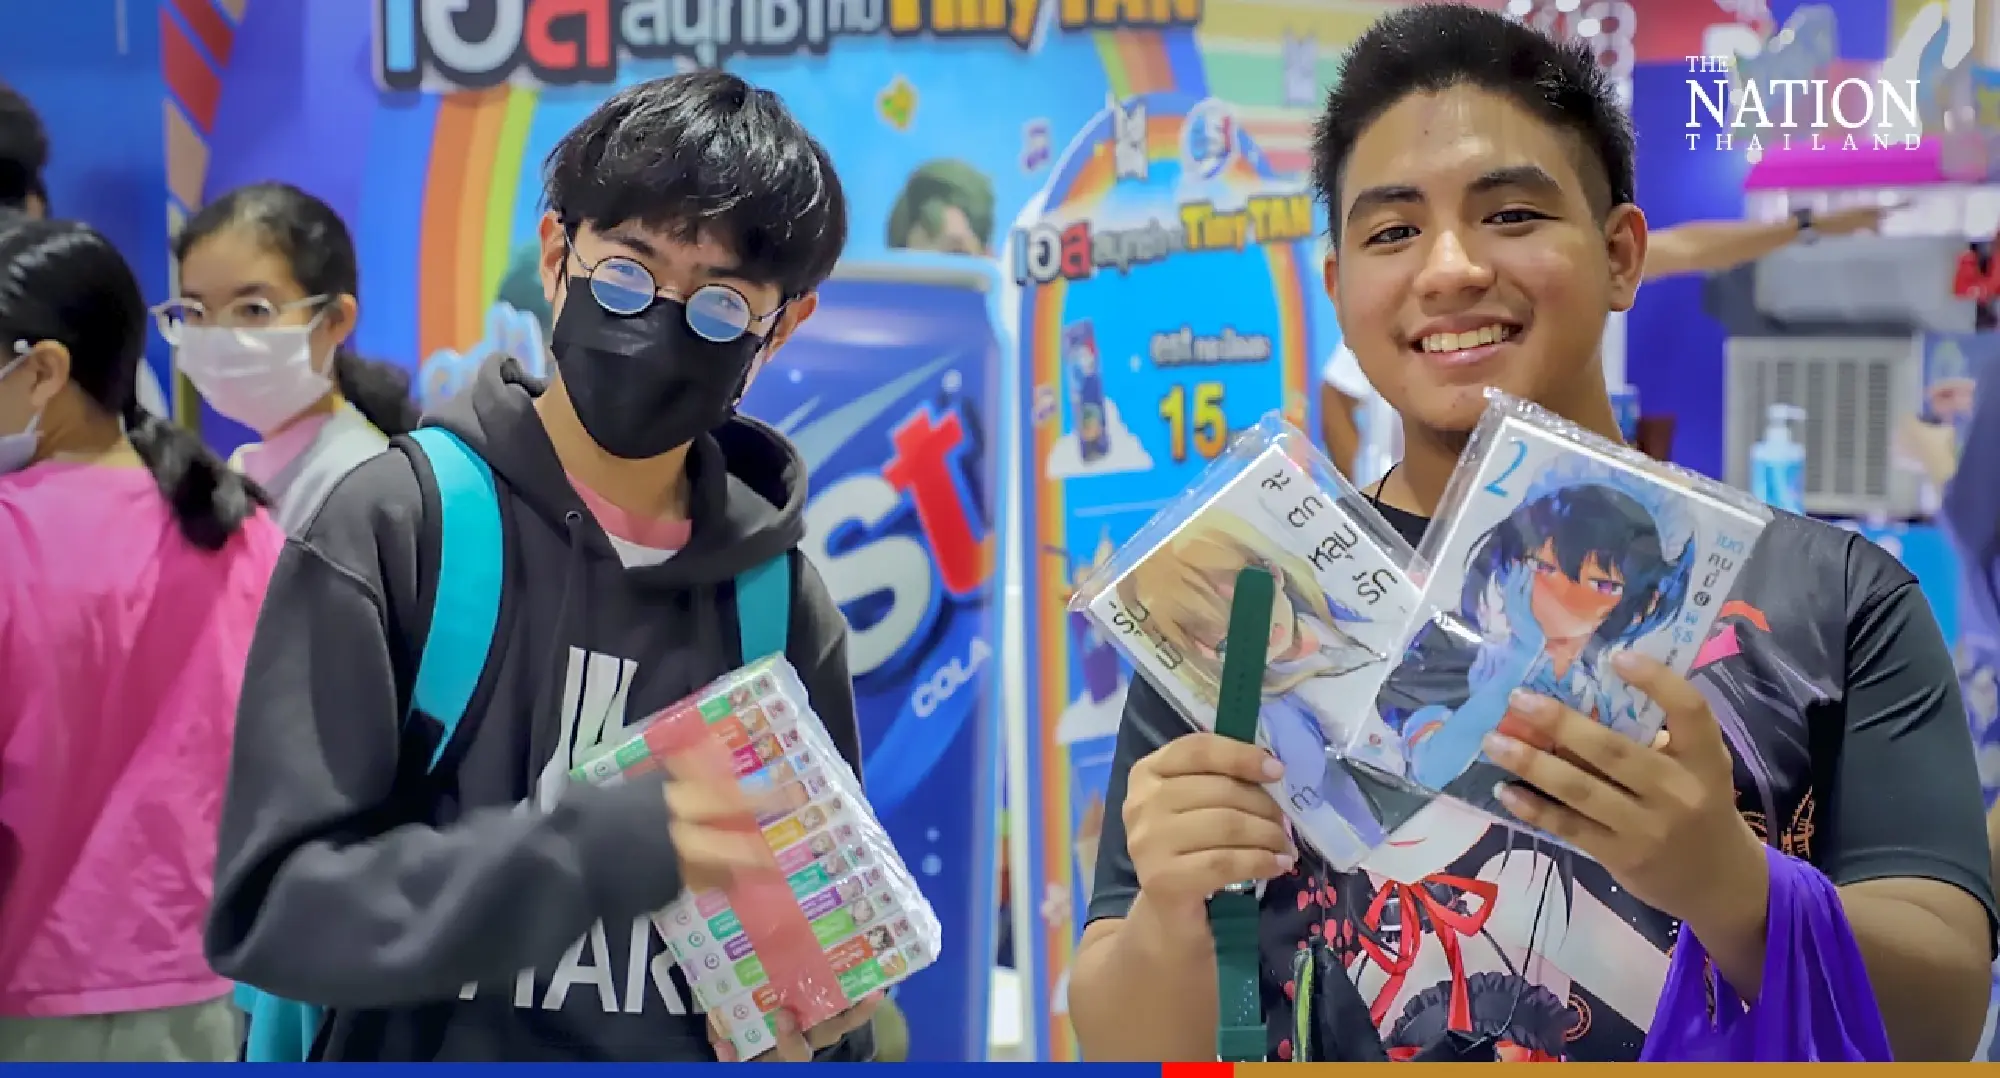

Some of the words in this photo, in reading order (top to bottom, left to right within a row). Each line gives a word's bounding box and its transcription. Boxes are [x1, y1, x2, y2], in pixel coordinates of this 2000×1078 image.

[1160, 382, 1228, 461] 15
[1484, 440, 1528, 498] 2
[800, 408, 995, 677] st
[911, 637, 992, 718] COLA
